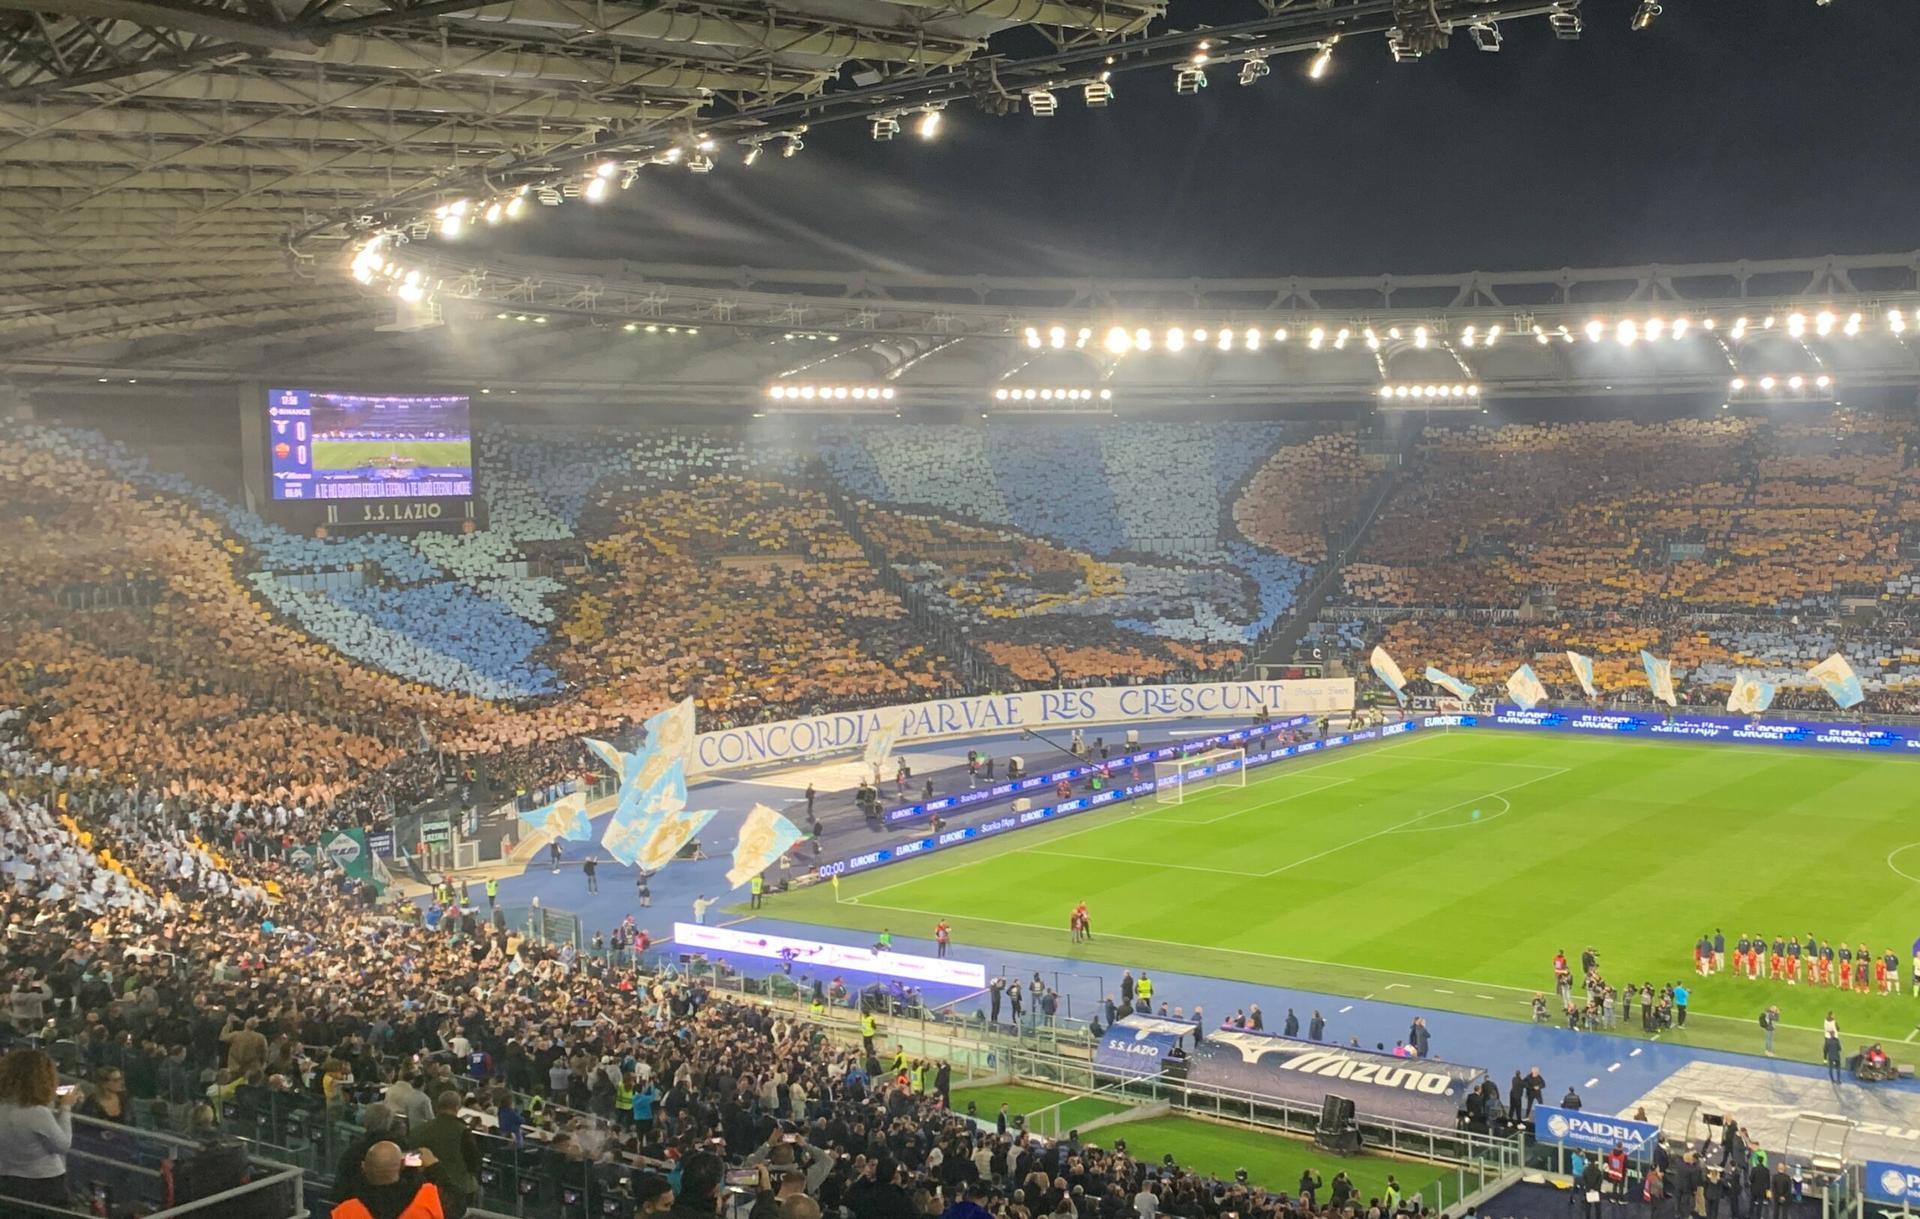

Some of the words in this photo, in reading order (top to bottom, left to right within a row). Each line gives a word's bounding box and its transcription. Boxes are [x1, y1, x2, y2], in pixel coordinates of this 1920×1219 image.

[296, 421, 306, 441] 0
[298, 445, 307, 465] 0
[364, 505, 390, 520] S.S.
[394, 503, 441, 519] LAZIO
[699, 713, 881, 767] CONCORDIA
[901, 696, 1024, 736] PARVAE
[1041, 690, 1096, 721] RES
[1120, 685, 1284, 715] CRESCUNT
[940, 829, 966, 845] EUROBET
[896, 840, 924, 856] EUROBET
[850, 851, 880, 868] EUROBET
[819, 861, 845, 877] 00:00
[1126, 1043, 1159, 1056] LAZIO
[1569, 1118, 1645, 1143] PAIDEIA
